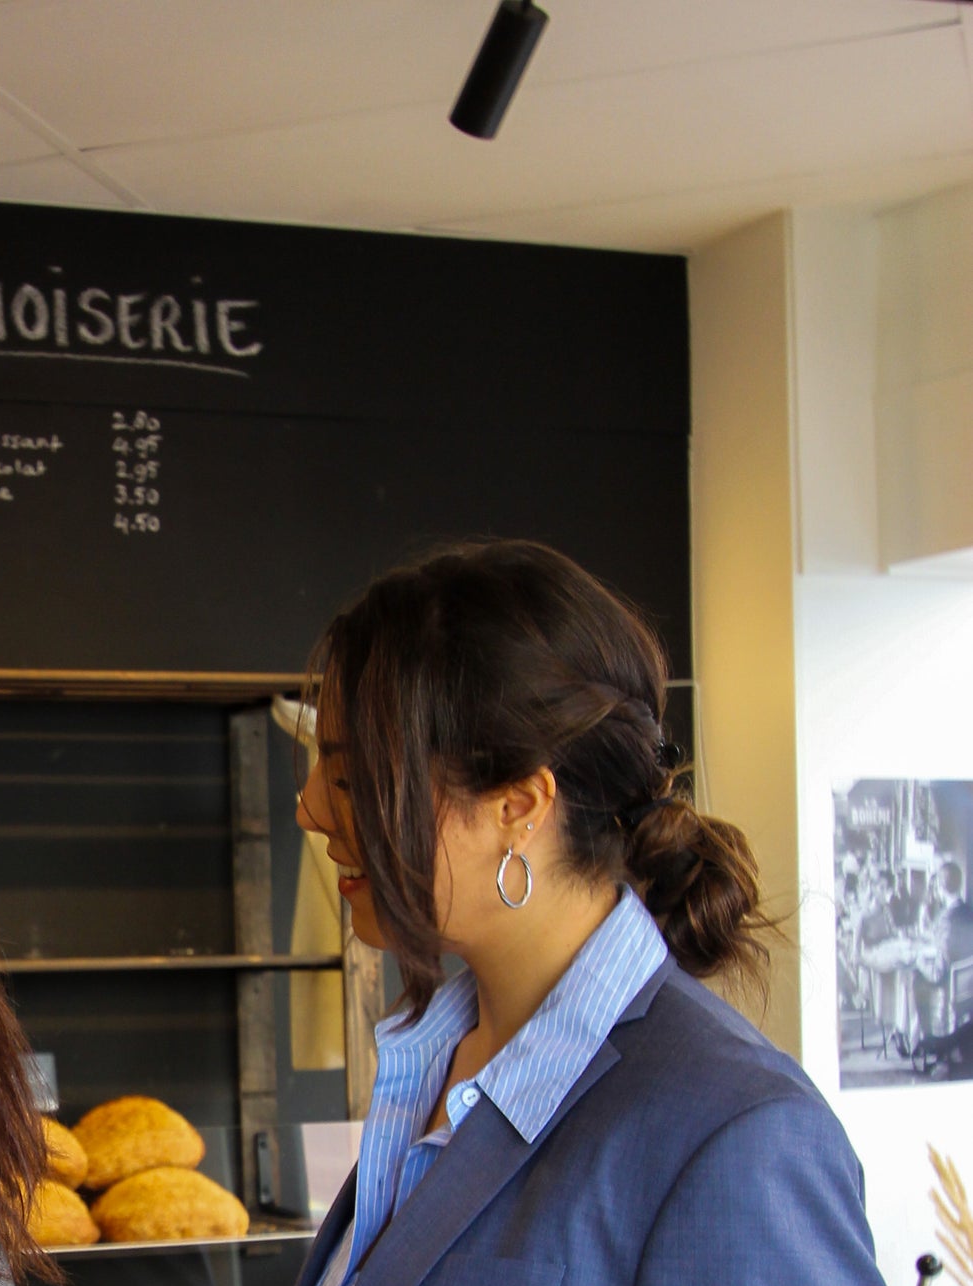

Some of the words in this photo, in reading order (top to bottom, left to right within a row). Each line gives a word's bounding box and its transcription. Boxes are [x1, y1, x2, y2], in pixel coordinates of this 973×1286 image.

[111, 409, 162, 432] 2.80
[113, 483, 160, 506] 3.50
[113, 511, 161, 535] 4.50
